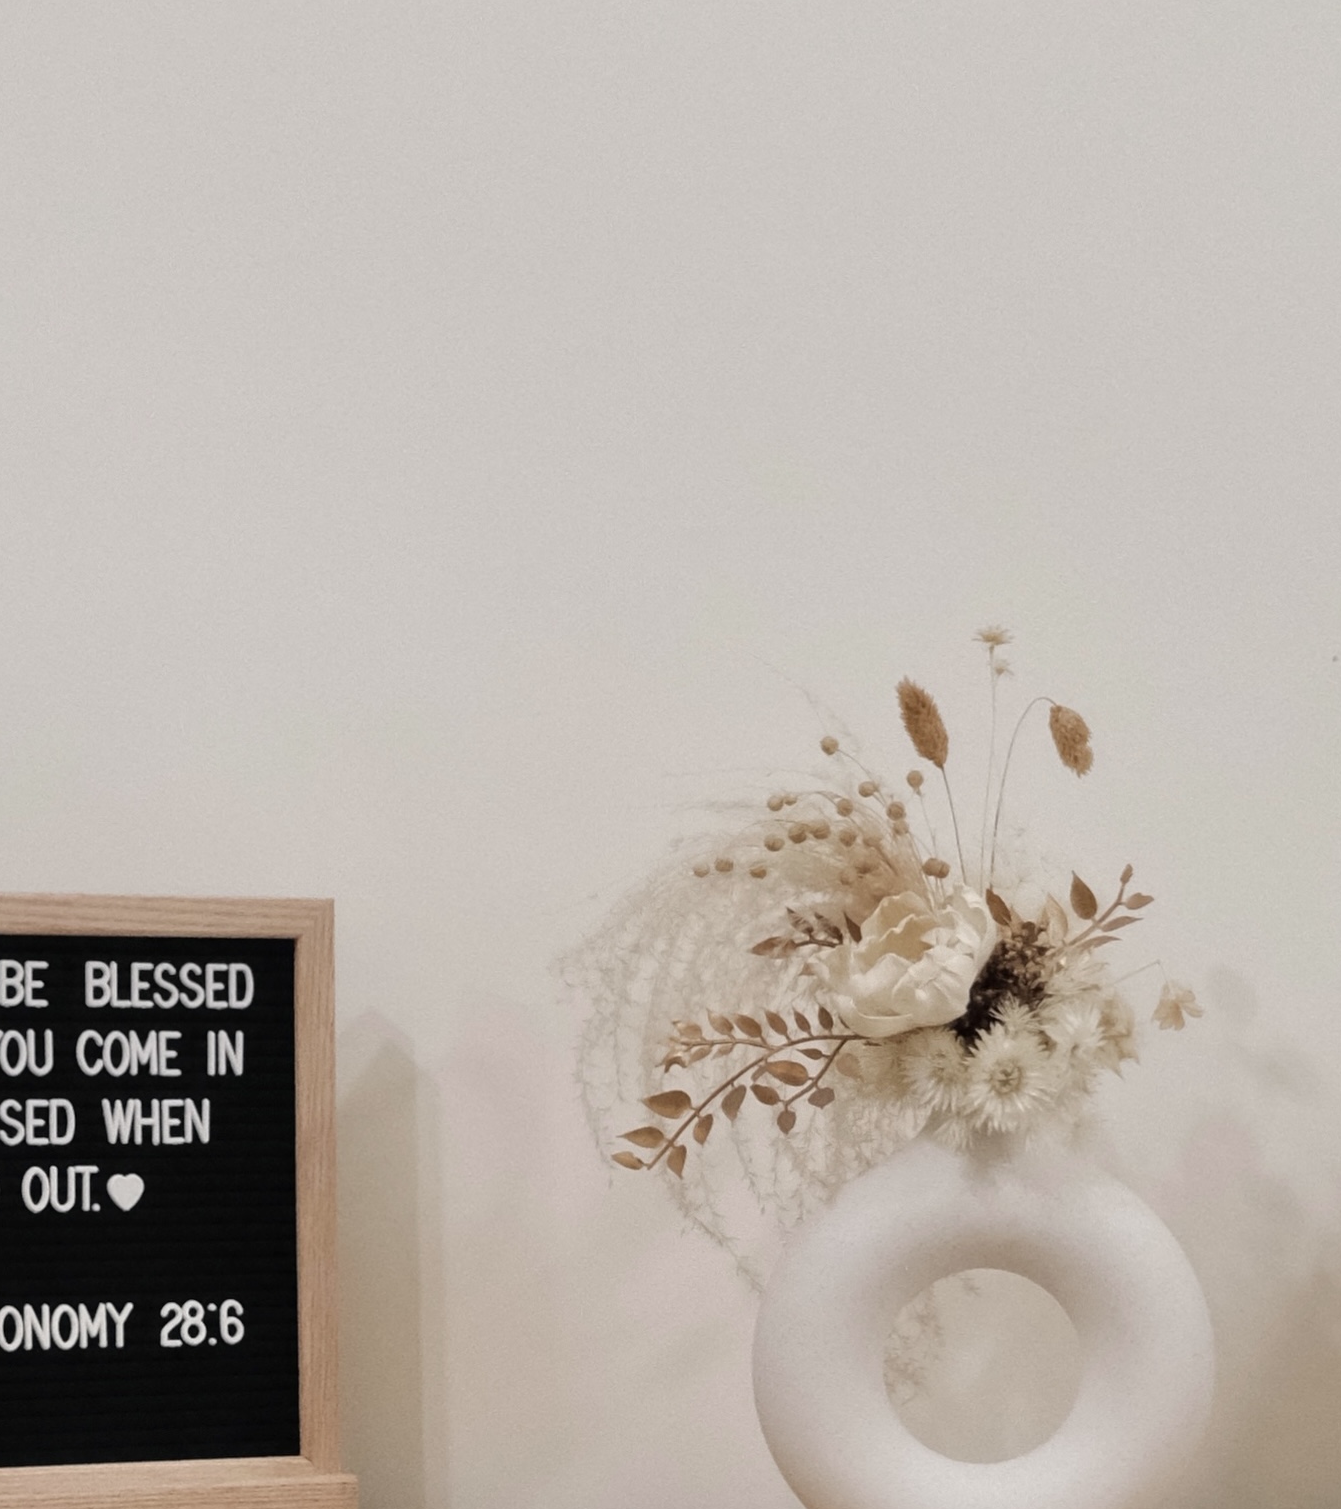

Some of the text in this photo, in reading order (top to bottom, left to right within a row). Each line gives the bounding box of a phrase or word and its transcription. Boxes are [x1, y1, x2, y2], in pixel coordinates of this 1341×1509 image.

[85, 961, 254, 1009] BLESSED
[76, 1030, 180, 1077] COME
[207, 1031, 243, 1077] IN
[102, 1098, 209, 1144] WHEN
[22, 1165, 99, 1212] OUT.
[160, 1299, 244, 1347] 28:6
